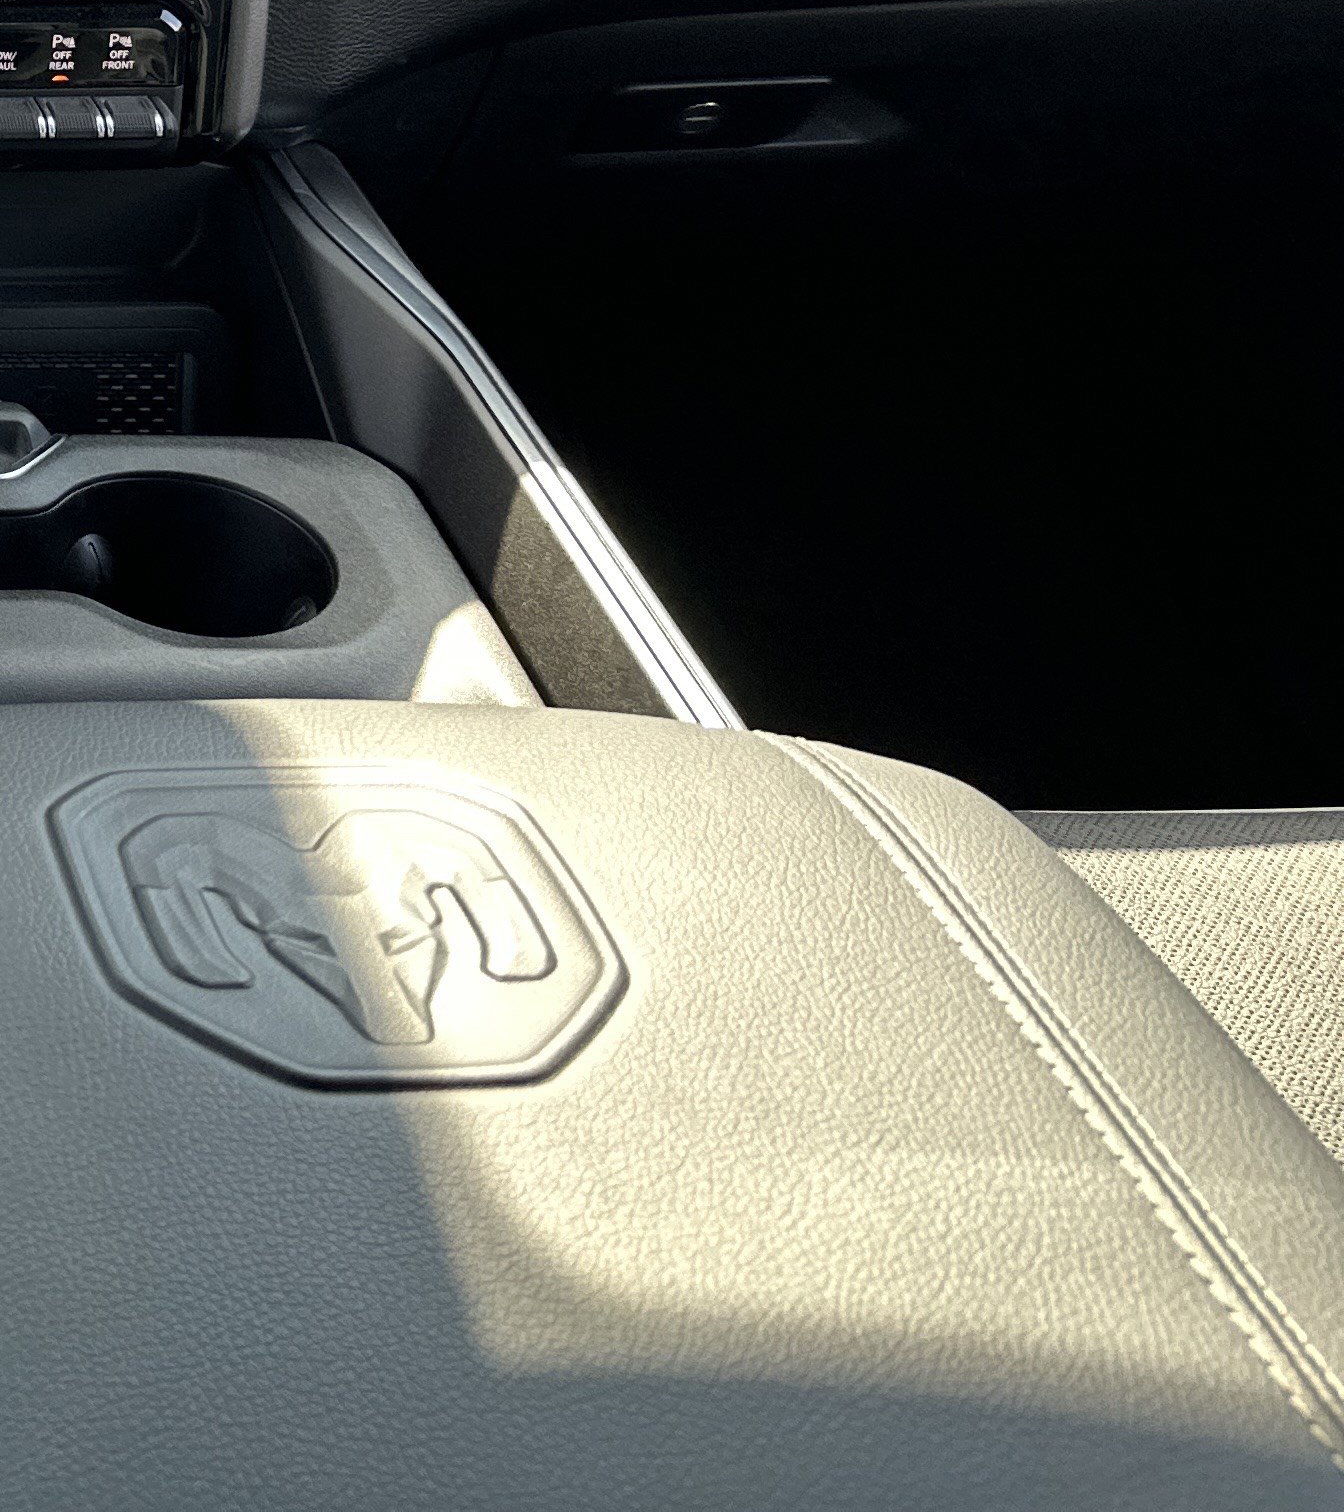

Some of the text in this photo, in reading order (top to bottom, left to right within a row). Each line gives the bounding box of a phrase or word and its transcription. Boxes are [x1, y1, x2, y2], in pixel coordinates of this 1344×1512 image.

[52, 50, 72, 60] OFF
[109, 49, 129, 59] OFF
[48, 61, 75, 71] REAR
[102, 60, 135, 70] FRONT
